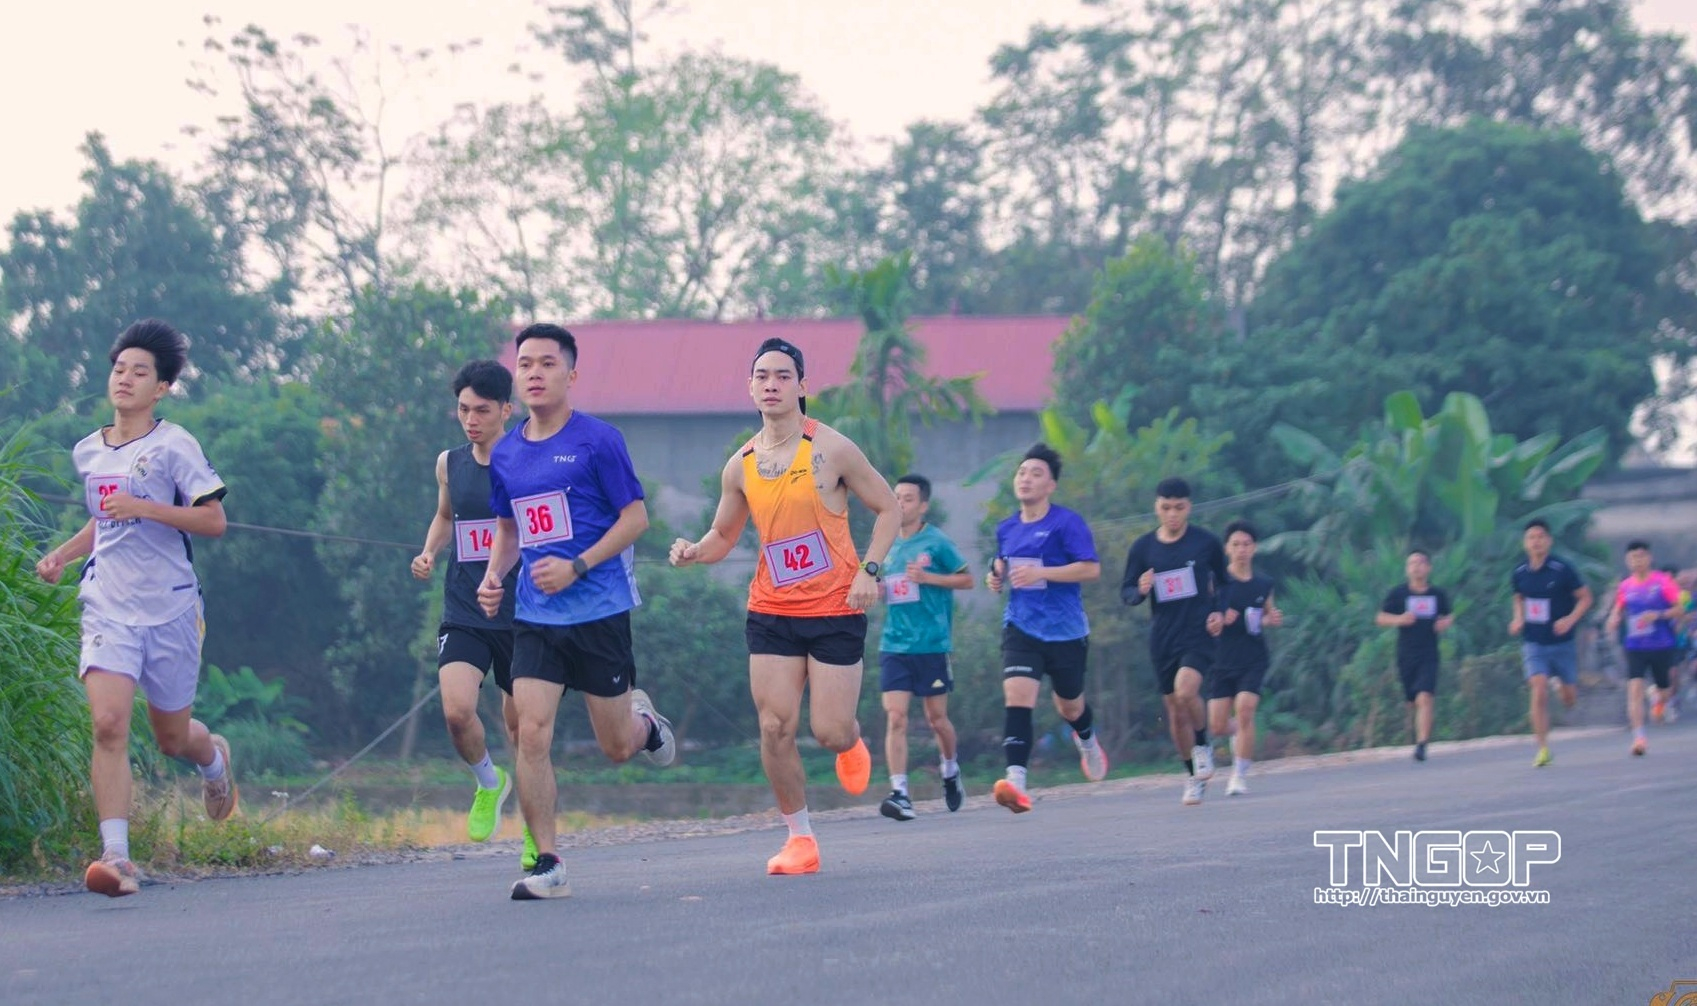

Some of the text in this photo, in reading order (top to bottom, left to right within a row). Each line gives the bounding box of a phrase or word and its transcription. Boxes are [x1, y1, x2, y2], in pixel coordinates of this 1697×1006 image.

[553, 455, 577, 463] TNG
[526, 505, 554, 535] 36
[469, 529, 493, 551] 14
[783, 544, 813, 571] 42
